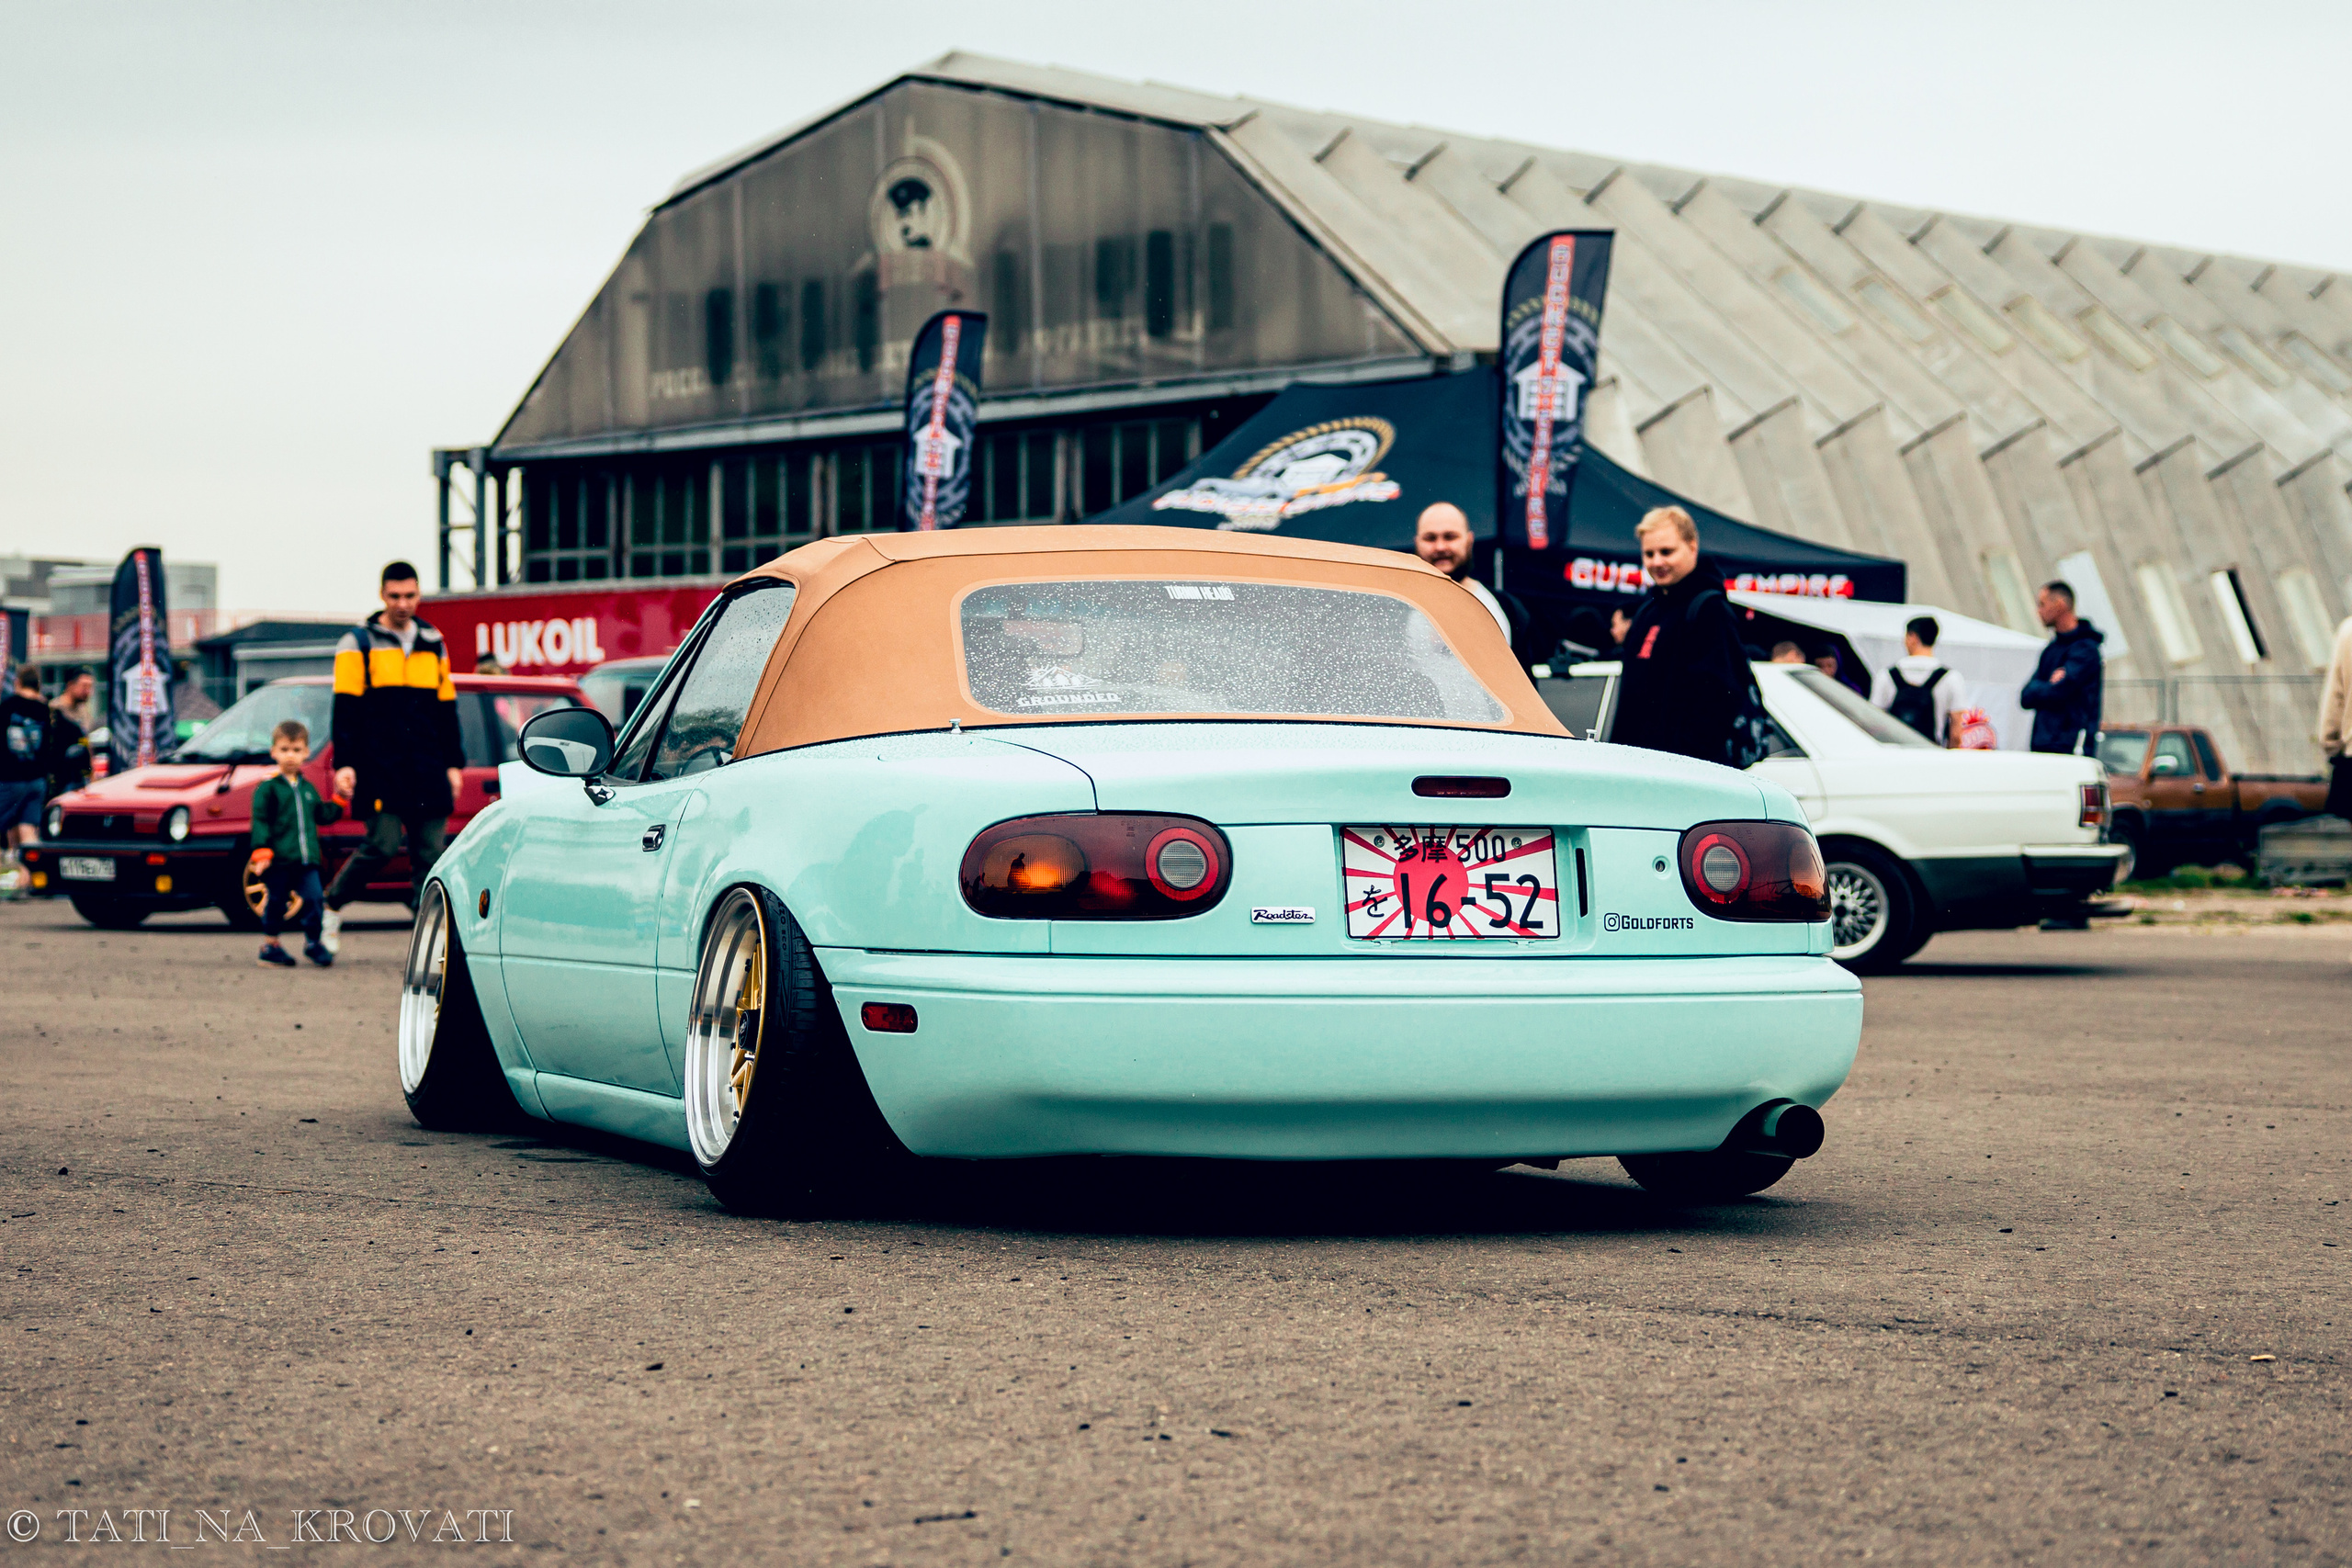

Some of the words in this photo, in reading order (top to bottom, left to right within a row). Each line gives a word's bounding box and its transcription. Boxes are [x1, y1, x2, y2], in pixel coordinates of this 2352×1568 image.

[1735, 573, 1849, 598] EMPIRE
[476, 616, 605, 668] LUKOIL
[1017, 692, 1122, 707] GROUNDED
[1456, 834, 1507, 863] 500
[1253, 909, 1315, 920] Roadster
[1400, 874, 1544, 929] 16-52
